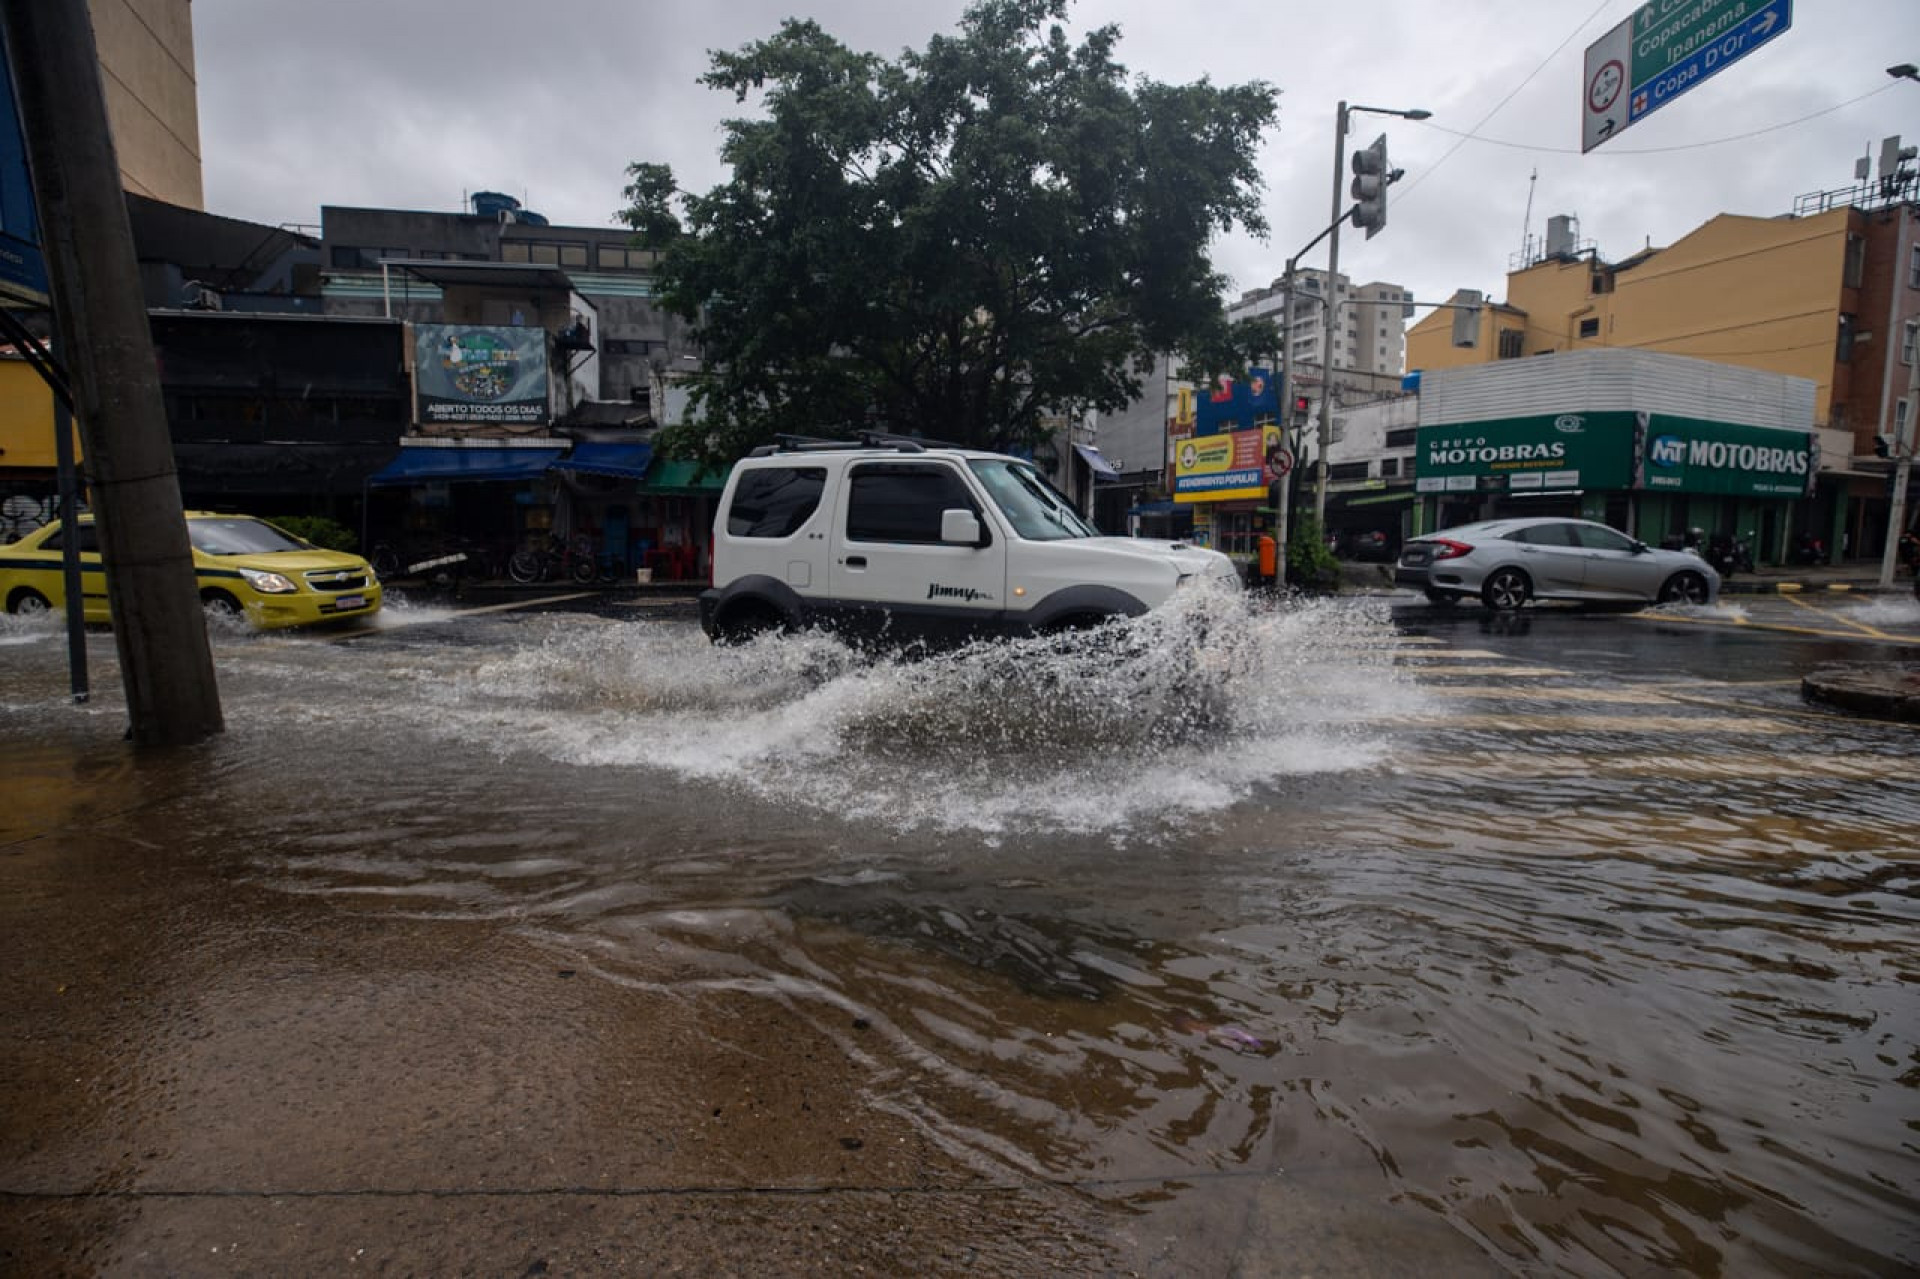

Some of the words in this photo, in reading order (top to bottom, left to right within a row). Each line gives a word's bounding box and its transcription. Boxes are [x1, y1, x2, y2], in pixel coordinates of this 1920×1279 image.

[1668, 2, 1746, 62] Ipanema
[1655, 64, 1698, 97] Copa
[1706, 34, 1746, 67] D'Or
[428, 403, 467, 413] ABERTO
[470, 404, 502, 413] TODOS
[504, 405, 518, 414] OS
[520, 405, 543, 415] DIAS
[1430, 437, 1486, 449] GRUPO
[1430, 442, 1565, 465] MOTOBRAS
[1689, 440, 1808, 475] MOTOBRAS
[927, 583, 975, 602] Jimny
